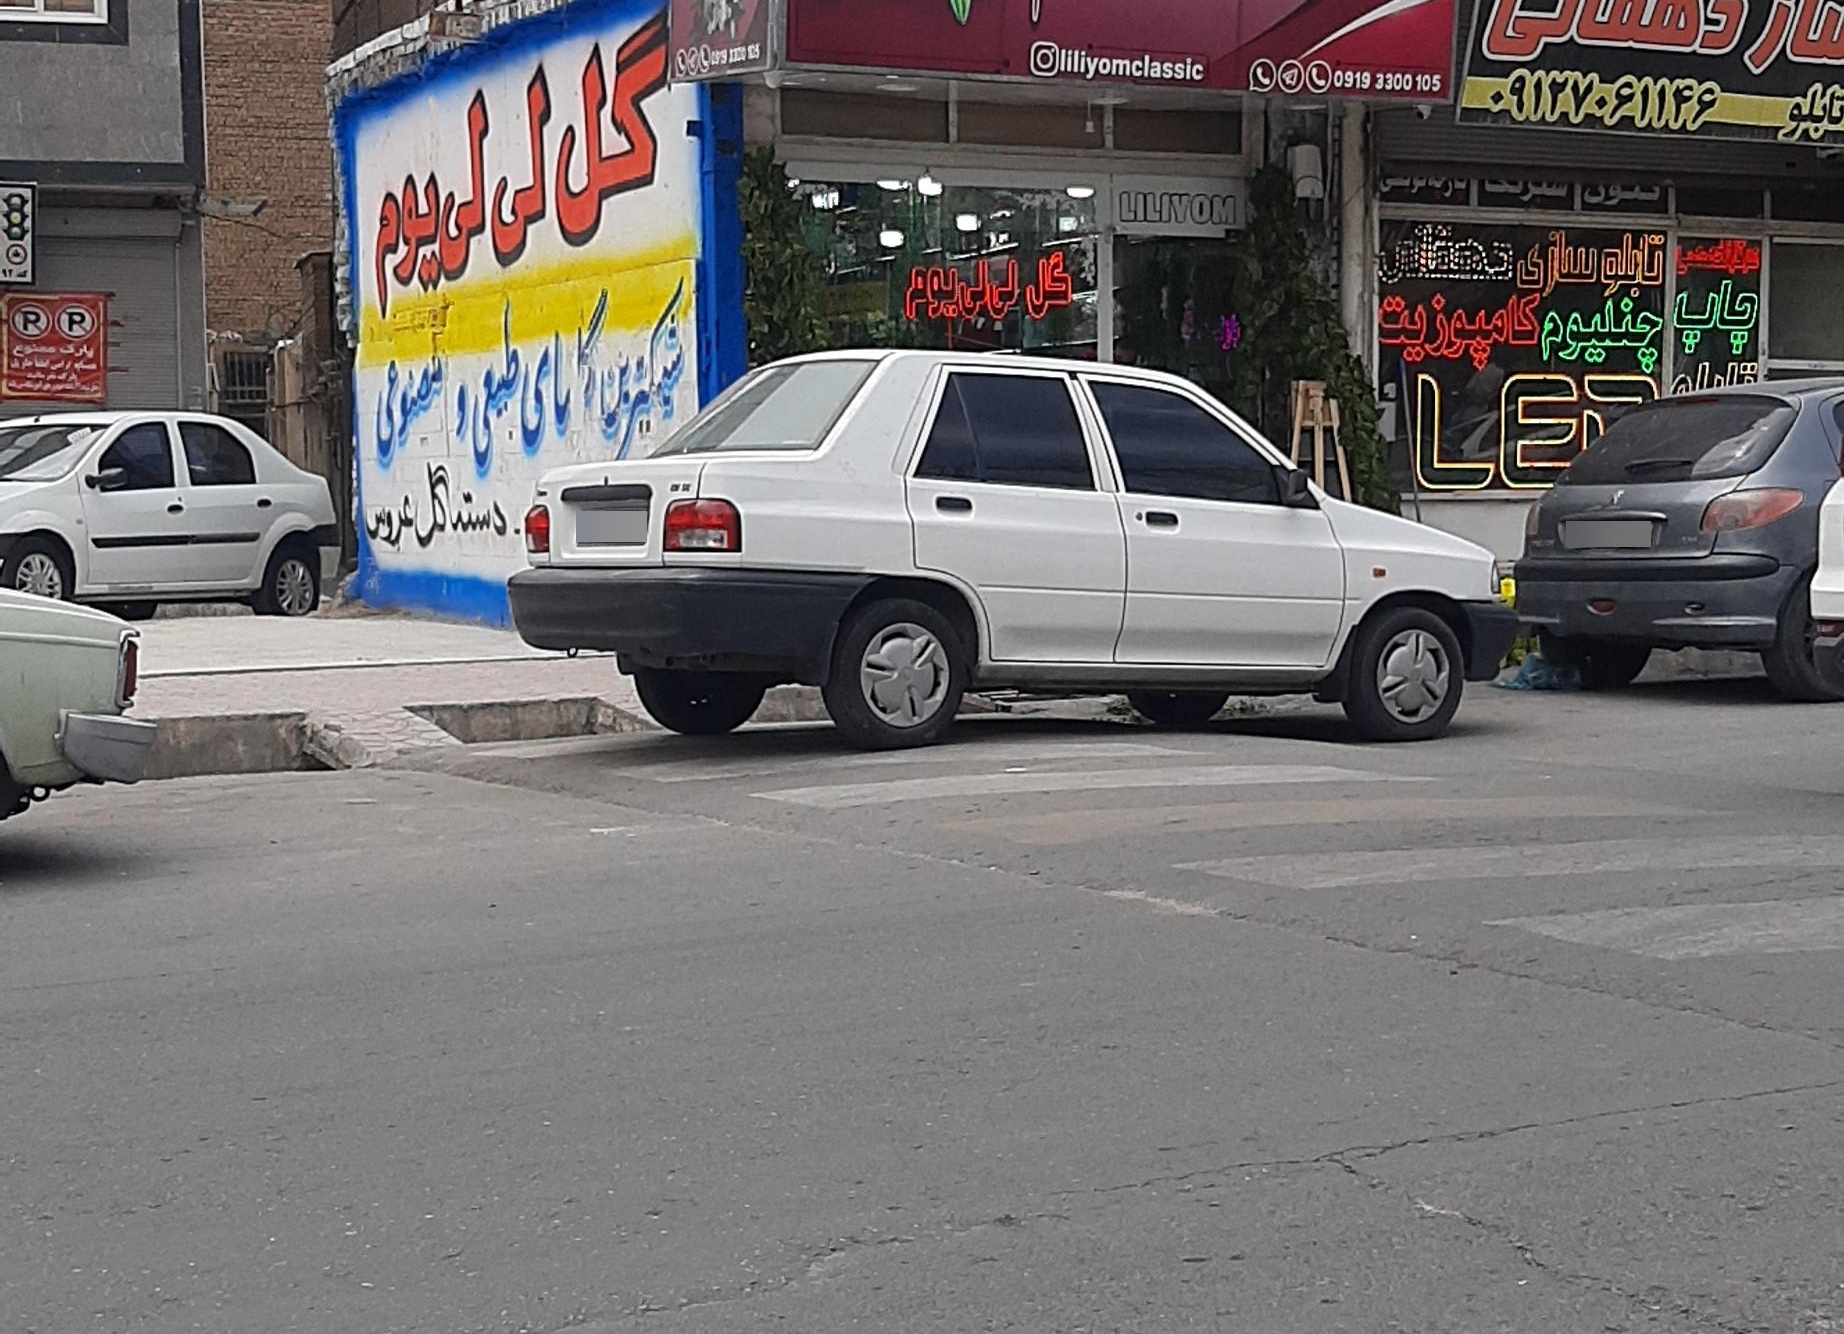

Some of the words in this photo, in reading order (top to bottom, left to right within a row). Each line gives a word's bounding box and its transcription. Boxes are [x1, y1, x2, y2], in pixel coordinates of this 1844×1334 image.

[1060, 47, 1204, 81] liliyomclassic
[1333, 71, 1370, 89] 0919
[1376, 72, 1413, 91] 3300
[1416, 74, 1441, 92] 105
[556, 10, 670, 248] گل
[439, 88, 489, 280] لی
[491, 60, 550, 268] لی
[1120, 192, 1236, 224] LILIYOM
[375, 172, 440, 319] یوم
[1517, 229, 1597, 296] سازی
[1600, 233, 1664, 298] تابلو
[906, 267, 959, 320] یوم
[958, 260, 988, 319] لی
[987, 260, 1019, 319] لی
[1025, 251, 1072, 319] گل
[1673, 280, 1758, 354] چاپ
[1377, 292, 1543, 371] کامپوزیت
[1542, 296, 1663, 373] چنلیوم
